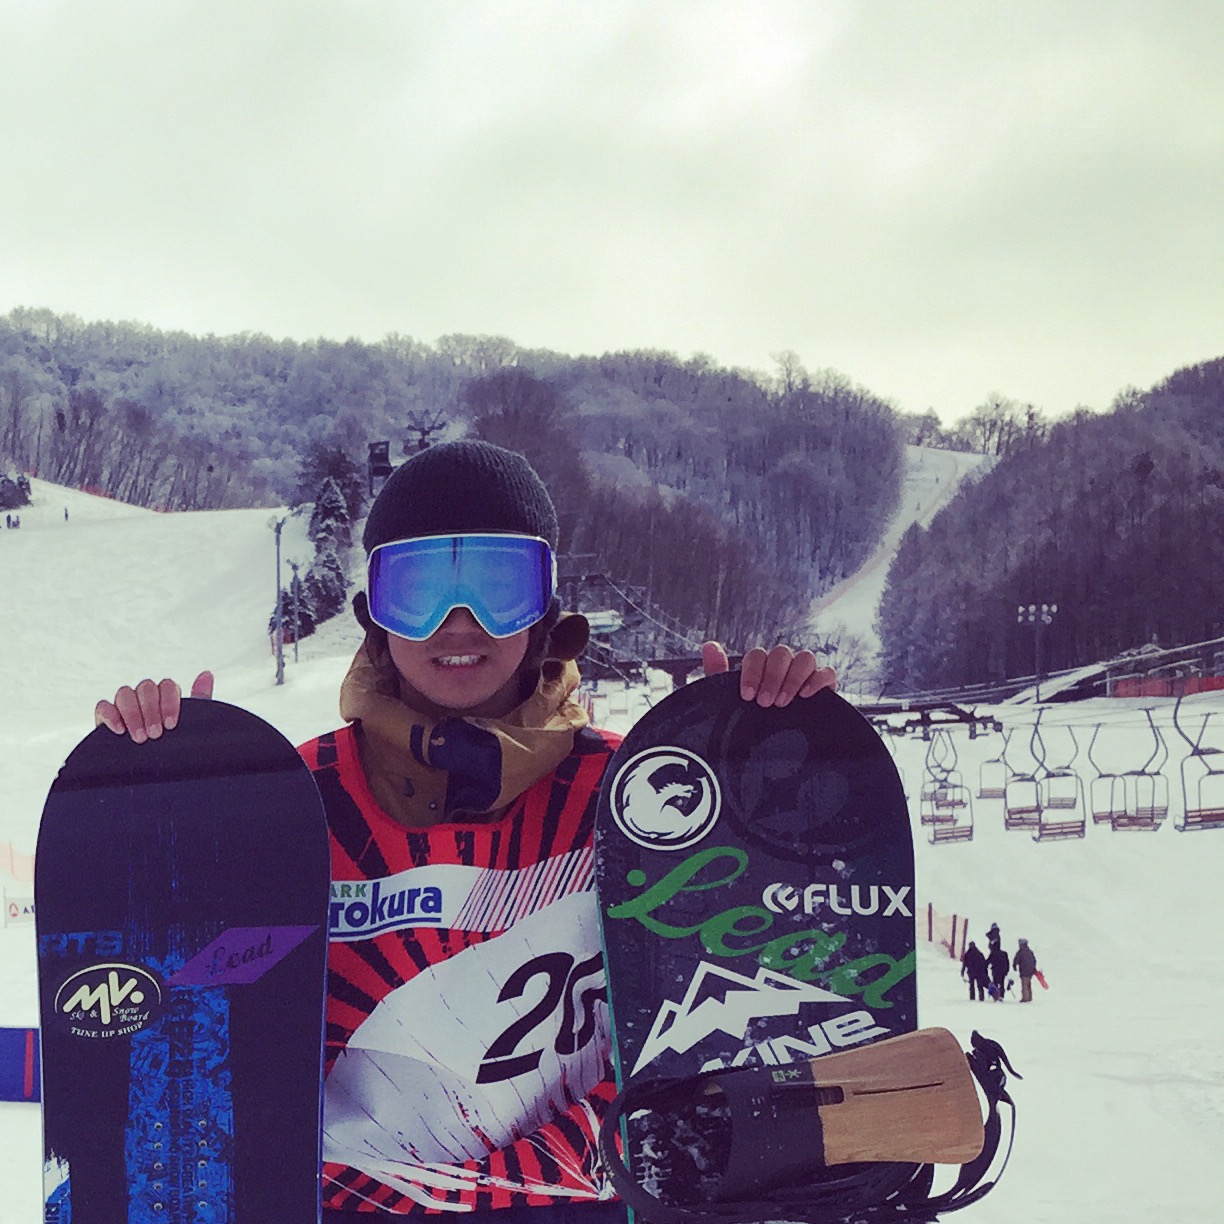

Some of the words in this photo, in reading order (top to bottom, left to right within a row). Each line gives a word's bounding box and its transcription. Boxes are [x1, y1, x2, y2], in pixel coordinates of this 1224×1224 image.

[804, 884, 913, 917] FLUX
[607, 846, 915, 1009] Lead
[71, 1026, 98, 1038] TUNE
[101, 1030, 116, 1038] UP
[117, 1021, 144, 1036] SHOP
